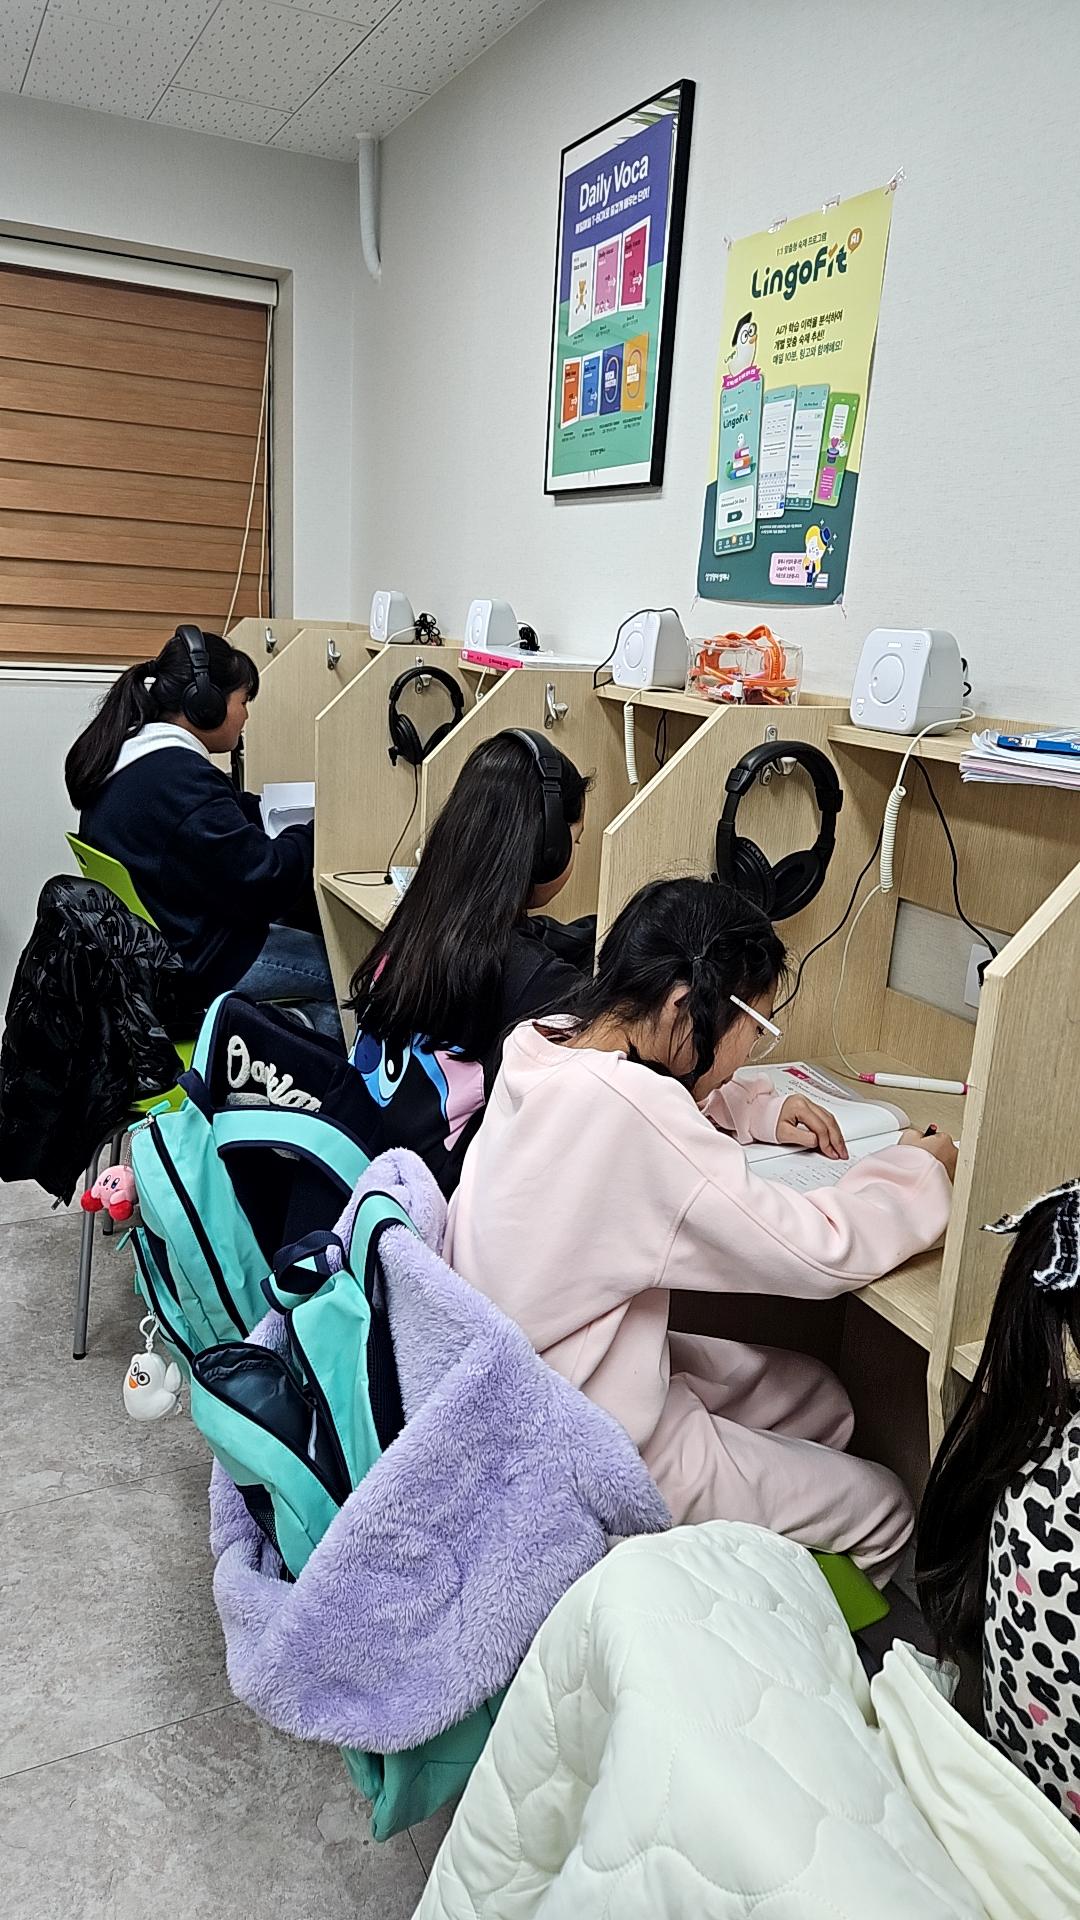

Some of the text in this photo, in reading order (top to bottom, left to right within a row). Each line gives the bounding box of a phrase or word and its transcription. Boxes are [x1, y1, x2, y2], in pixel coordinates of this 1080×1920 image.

[579, 155, 649, 213] Daily Voca
[808, 232, 827, 246] 프로그램
[775, 308, 843, 336] AI가 학습 이력을 분석하여
[772, 352, 784, 365] 매일
[817, 340, 843, 356] 함께해요!
[774, 329, 825, 351] 개별 맞춤 숙제 추천!
